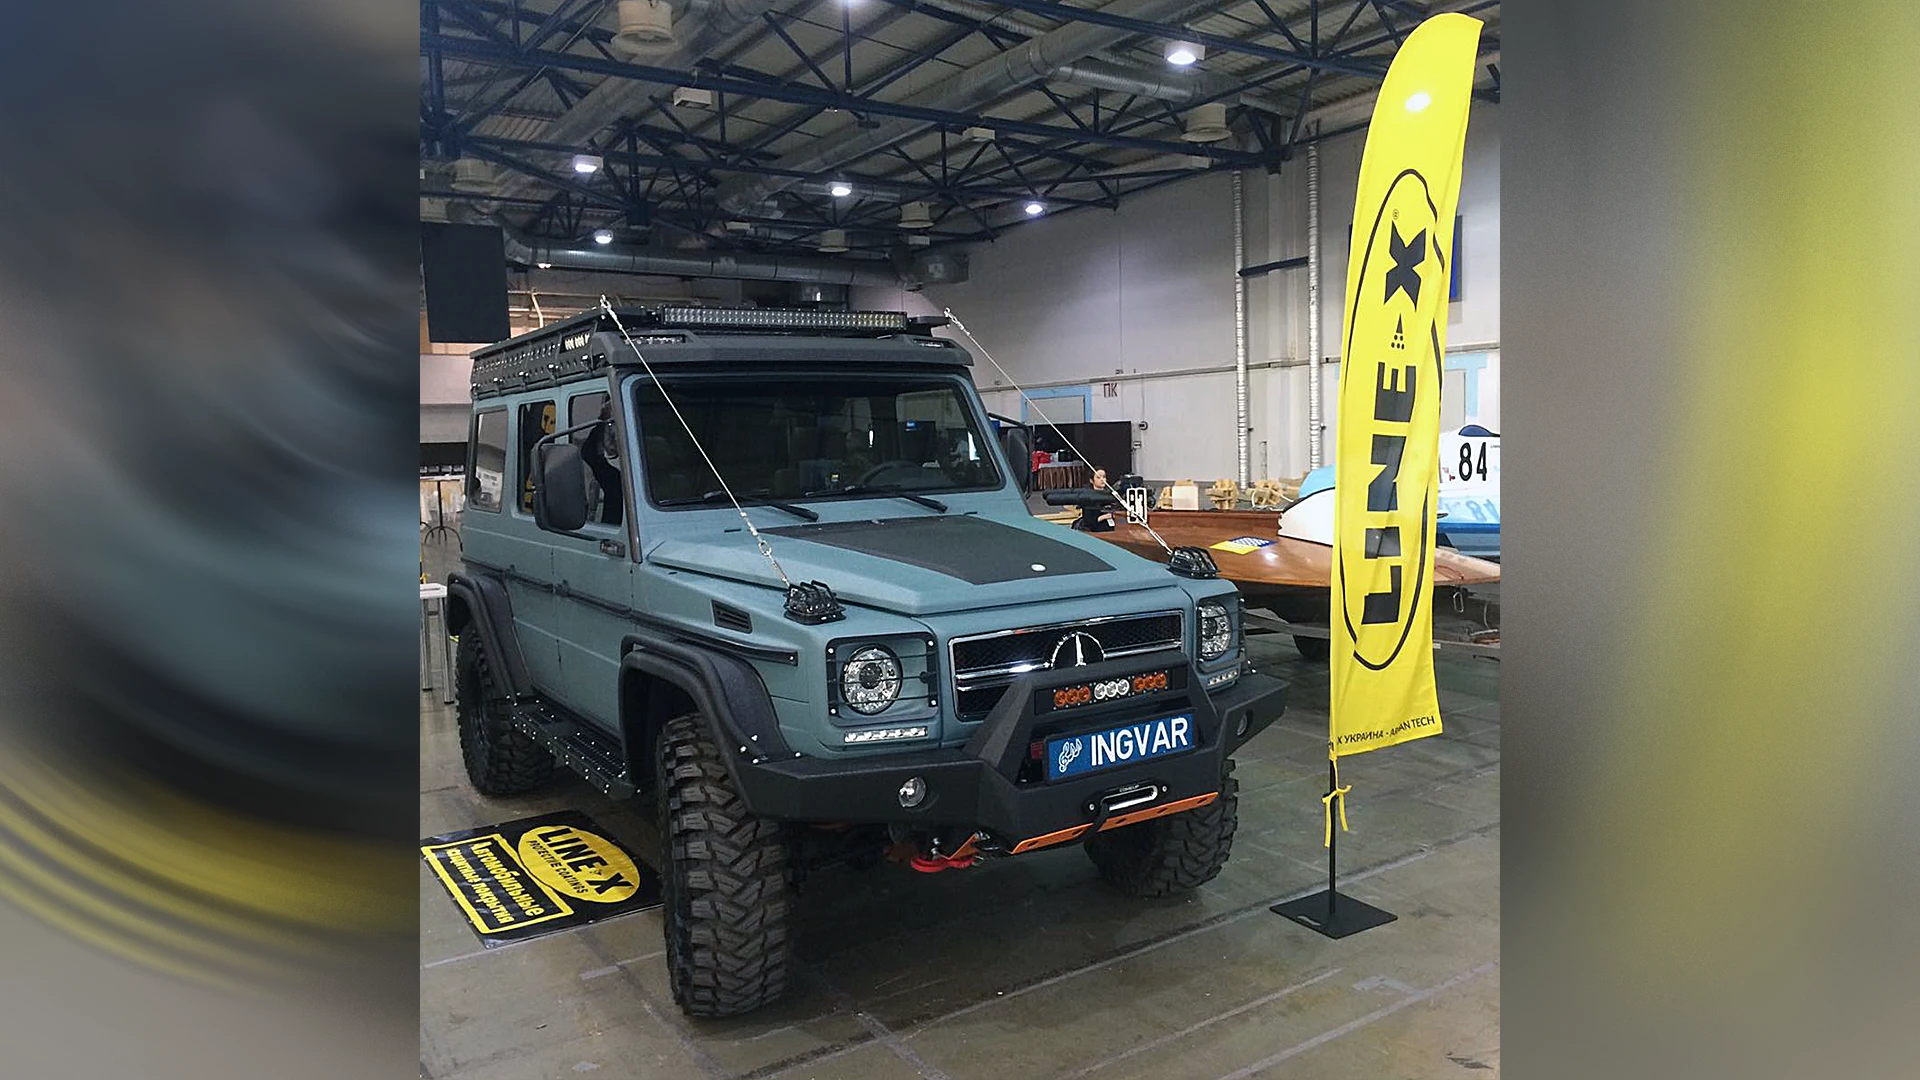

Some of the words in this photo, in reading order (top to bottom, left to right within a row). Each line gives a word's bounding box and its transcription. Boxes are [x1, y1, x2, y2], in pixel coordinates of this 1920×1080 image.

[1459, 442, 1487, 481] 84
[1091, 717, 1188, 766] INGVAR
[1344, 730, 1384, 744] УКРАИНА
[1411, 715, 1436, 729] TECH
[471, 841, 545, 917] Автомобильные
[555, 867, 589, 894] COATINGS
[471, 882, 515, 924] покрытия
